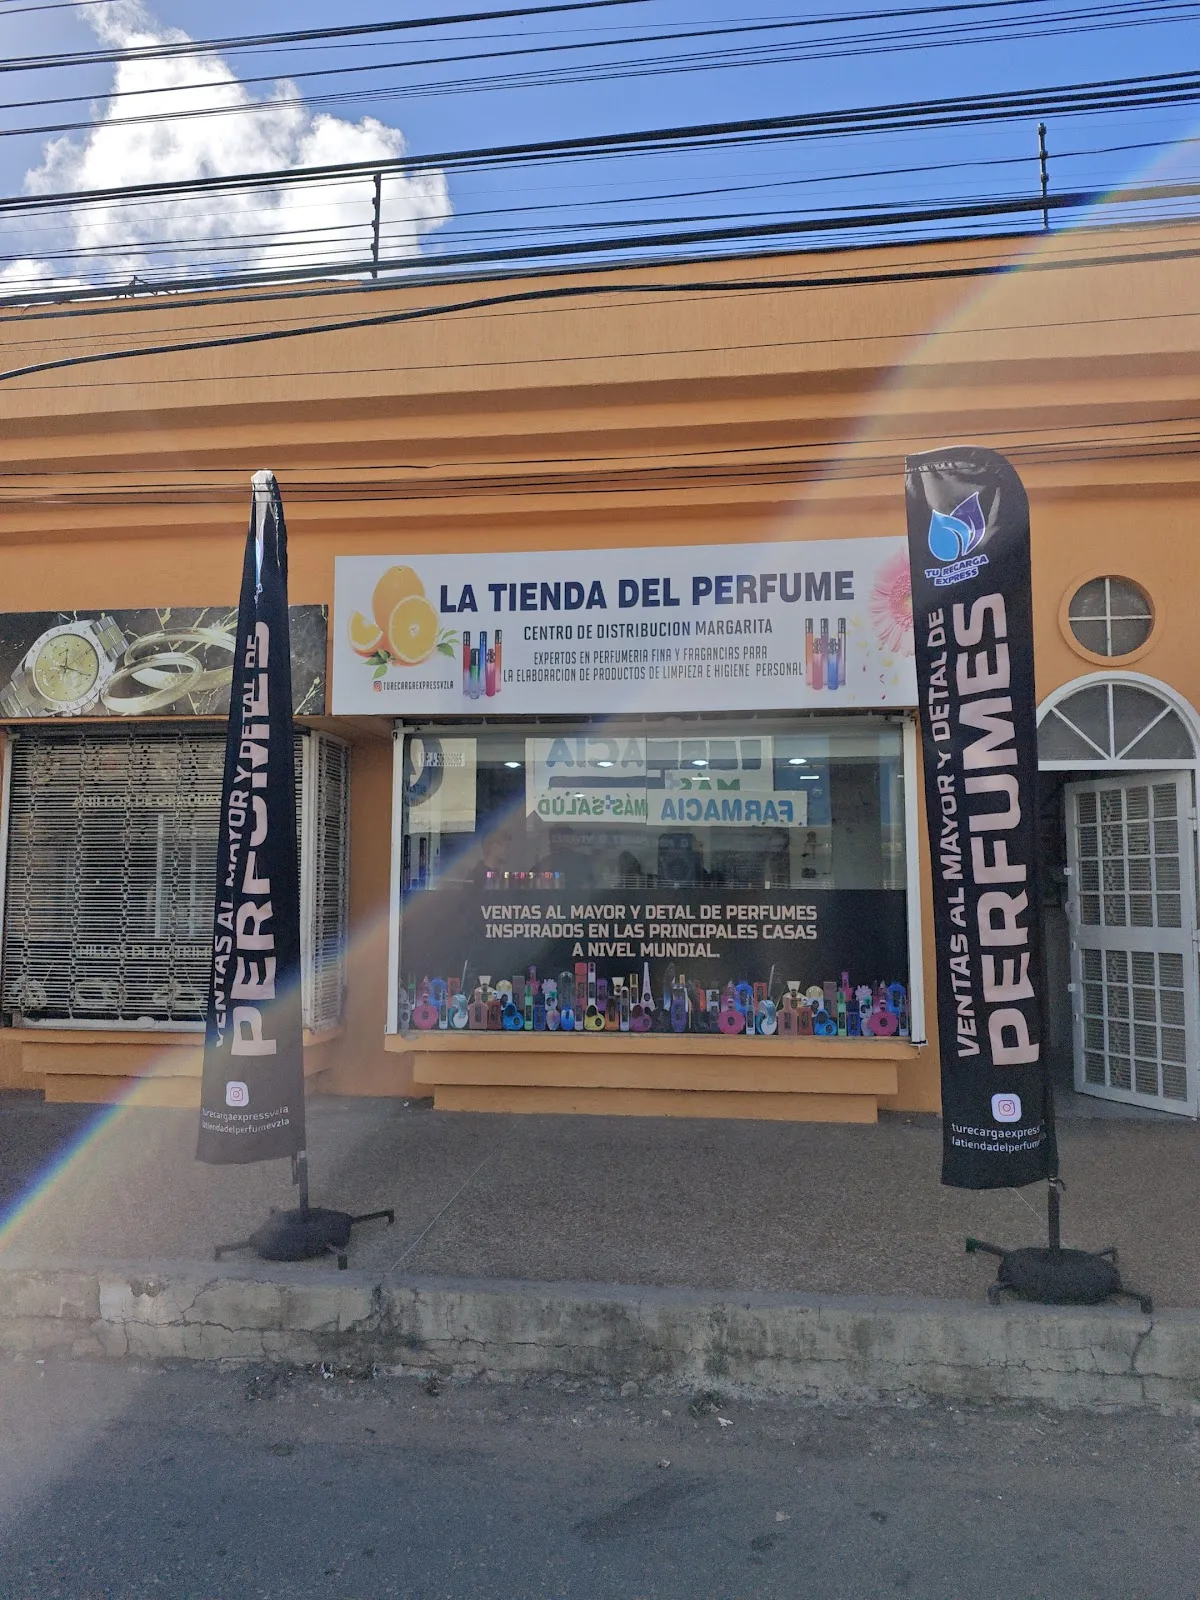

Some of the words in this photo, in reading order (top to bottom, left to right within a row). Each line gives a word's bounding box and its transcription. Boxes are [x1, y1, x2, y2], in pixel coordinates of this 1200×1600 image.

[925, 568, 941, 579] TU
[941, 554, 989, 578] RECARGA
[934, 567, 979, 586] EXPRESS
[440, 584, 478, 613] LA
[488, 580, 608, 612] TIENDA
[618, 578, 681, 609] DEL
[692, 571, 855, 606] PERFUME
[524, 625, 572, 640] CENTRO
[577, 624, 593, 639] DE
[598, 621, 691, 639] DISTRIBUCION
[695, 618, 773, 636] MARGARITA
[927, 608, 946, 647] DE
[534, 651, 577, 665] EXPERTOS
[580, 650, 590, 664] EN
[593, 649, 648, 664] PERFUMERIA
[651, 648, 671, 662] FINA
[675, 647, 680, 661] Y
[684, 646, 740, 661] FRAGANCIAS
[743, 645, 767, 660] PARA
[503, 669, 513, 683] LA
[516, 668, 576, 682] ELABORACION
[580, 668, 591, 681] DE
[593, 666, 646, 681] PRODUCTOS
[649, 665, 660, 679] DE
[663, 664, 703, 679] LIMPIEZA
[706, 664, 711, 678] E
[714, 663, 750, 678] HIGIENE
[756, 662, 803, 677] PERSONAL
[383, 680, 454, 691] TURECARGAEXPRESSVZLA
[928, 651, 950, 742] DETAL
[239, 678, 255, 759] DETAL
[937, 749, 951, 770] Y
[234, 765, 251, 784] Y
[937, 774, 963, 880] MAYOR
[953, 592, 1040, 1066] PERFUMES
[481, 905, 541, 920] VENTAS
[546, 905, 566, 920] AL
[570, 905, 626, 920] MAYOR
[630, 905, 641, 920] Y
[645, 905, 696, 920] DETAL
[700, 905, 721, 920] DE
[726, 905, 817, 920] PERFUMES
[948, 887, 967, 927] AL
[485, 924, 584, 938] INSPIRADOS
[588, 924, 609, 938] EN
[614, 924, 644, 938] LAS
[649, 924, 758, 939] PRINCIPALES
[762, 924, 817, 939] CASAS
[572, 942, 584, 957] A
[588, 942, 635, 957] NIVEL
[640, 943, 720, 958] MUNDIAL.
[213, 935, 233, 1048] VENTAS
[949, 933, 980, 1057] VENTAS
